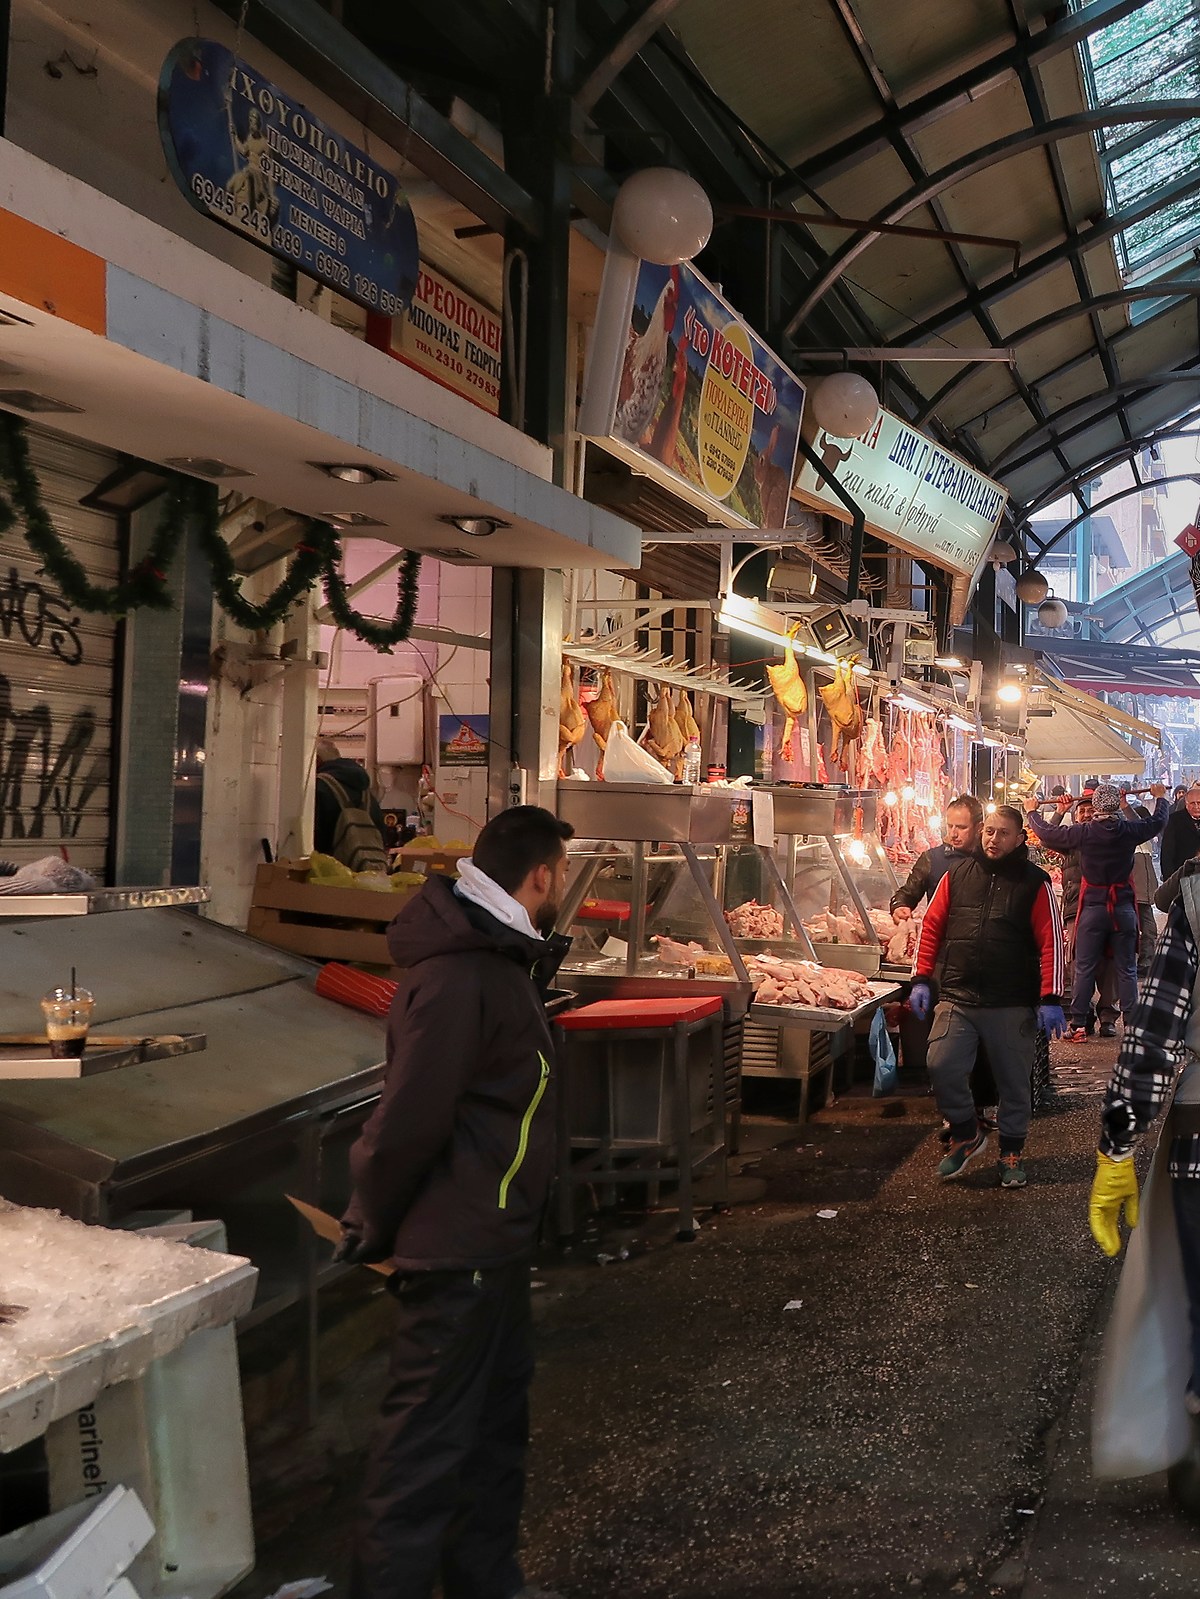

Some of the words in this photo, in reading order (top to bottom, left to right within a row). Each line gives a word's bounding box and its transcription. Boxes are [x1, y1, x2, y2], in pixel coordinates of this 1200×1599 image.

[231, 67, 389, 199] ΙΧΘΥΟΠΩΛΕΙΟ
[266, 123, 366, 212] ΠΟΣΕΙΔΩΝΑΣ
[258, 152, 320, 210] ΦΡΕΣΚΑ
[322, 193, 366, 240] ΨΑΡΙΑ
[289, 204, 337, 250] ΜΕΝΕΞΕ
[336, 236, 346, 255] 9
[191, 173, 236, 216] 6945
[241, 204, 271, 238] 243
[273, 224, 302, 259] 489
[315, 249, 350, 289] 6972
[354, 273, 378, 305] 126
[408, 305, 460, 354] ΜΠΟΥΡΑΣ
[436, 349, 464, 375] 2310
[705, 379, 749, 434] ΠΟΥΛΕΡΙΚΑ
[841, 470, 865, 494] και
[863, 483, 899, 510] καλά
[894, 495, 907, 517] &
[905, 504, 943, 534] φθηνά
[924, 450, 1004, 524] ΣΤΕΦΑΝΟΥΔΑΚΗΣ
[78, 1401, 107, 1498] arineh
